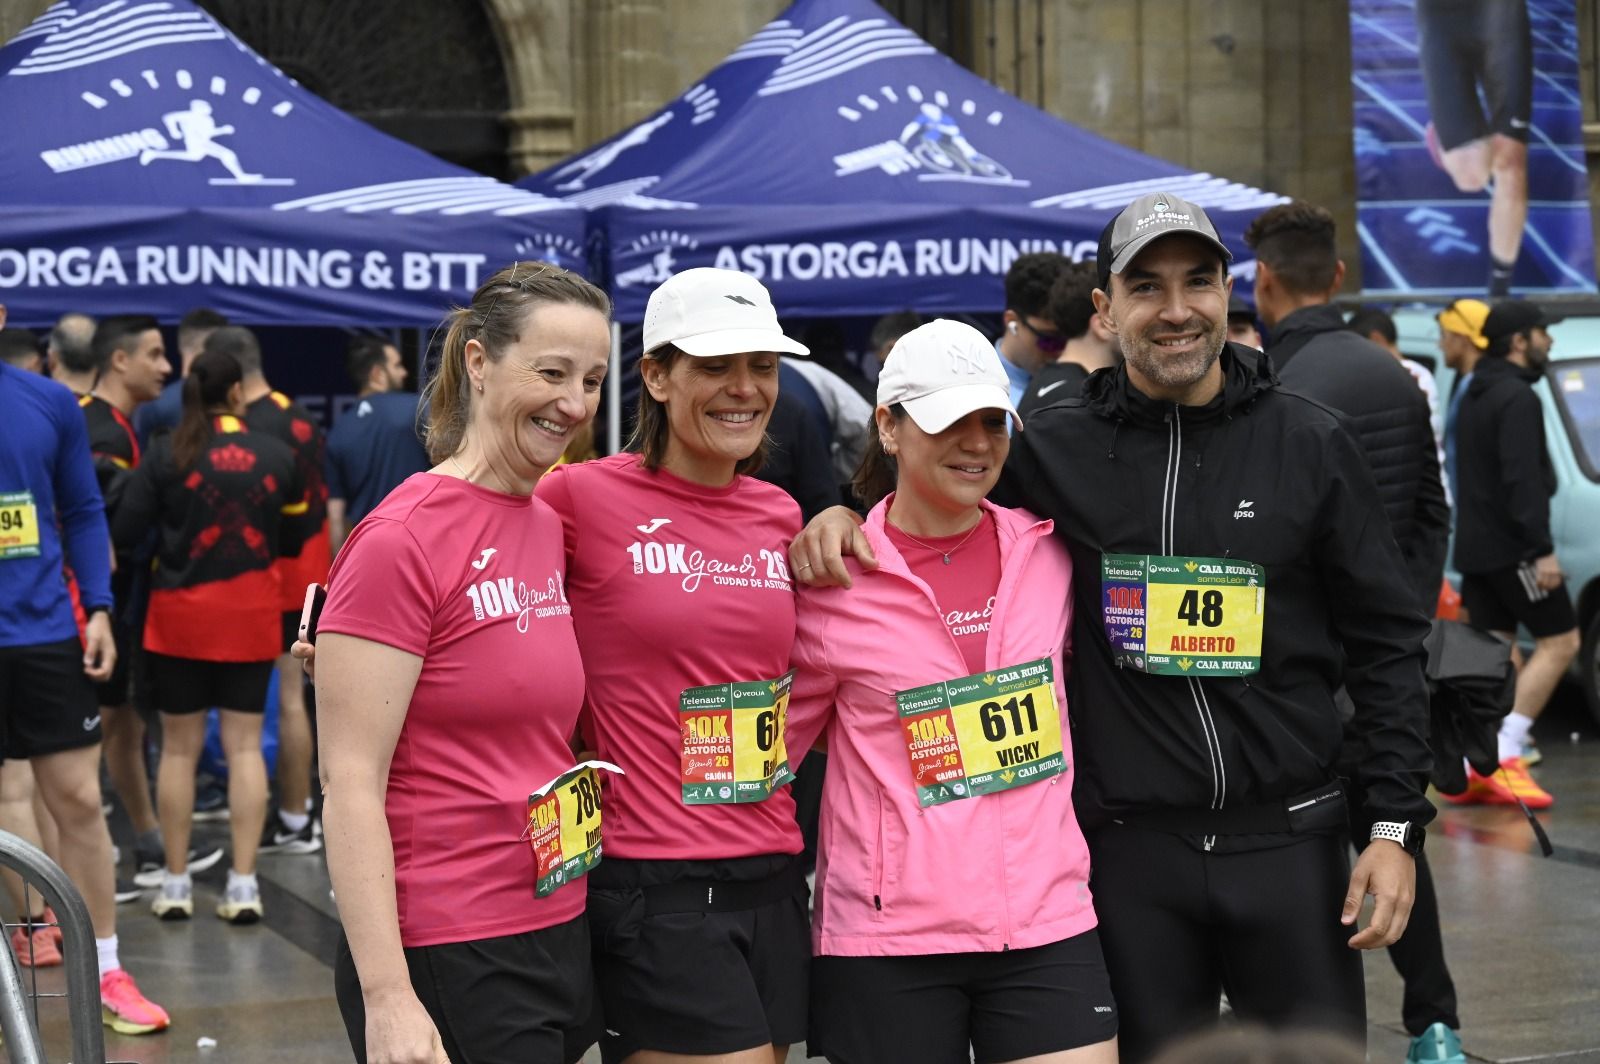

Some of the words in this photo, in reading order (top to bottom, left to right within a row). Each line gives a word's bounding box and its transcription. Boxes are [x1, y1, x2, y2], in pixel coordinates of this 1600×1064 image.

[0, 247, 128, 287] ORGA
[137, 246, 352, 289] RUNNING
[360, 251, 394, 290] &
[403, 252, 486, 291] BTT
[715, 242, 905, 281] ASTORGA
[1233, 511, 1255, 520] ipso
[626, 542, 690, 575] 10K
[759, 549, 790, 582] 26
[1199, 565, 1223, 574] CAJA
[1225, 566, 1258, 576] RURAL
[1105, 567, 1143, 576] Telenauto
[713, 575, 748, 587] CIUDAD
[750, 578, 763, 588] DE
[466, 577, 521, 620] 10K
[1107, 587, 1143, 609] 10K
[1105, 607, 1133, 615] CIUDAD
[1134, 608, 1145, 616] DE
[1177, 590, 1223, 627] 48
[1105, 616, 1145, 625] ASTORGA
[1130, 626, 1143, 638] 26
[1170, 636, 1235, 653] ALBERTO
[1196, 661, 1219, 669] CAJA
[1221, 661, 1255, 670] RURAL
[957, 684, 980, 694] VEOLIA
[997, 671, 1020, 683] CAJA
[1020, 664, 1048, 678] RURAL
[682, 696, 726, 705] Telenauto
[900, 696, 943, 711] Telenauto
[685, 715, 728, 738] 10K
[979, 693, 1039, 743] 611
[907, 714, 951, 742] 10K
[684, 736, 717, 745] CIUDAD
[719, 736, 731, 744] DE
[909, 737, 942, 751] CIUDAD
[943, 734, 955, 743] DE
[683, 745, 732, 755] ASTORGA
[911, 743, 958, 760] ASTORGA
[996, 741, 1040, 768] VICKY
[715, 755, 729, 767] 26
[943, 753, 958, 767] 26
[1018, 765, 1038, 778] CAJA
[1039, 757, 1062, 773] RURAL
[530, 799, 557, 831] 10K
[533, 828, 560, 850] ASTORGA
